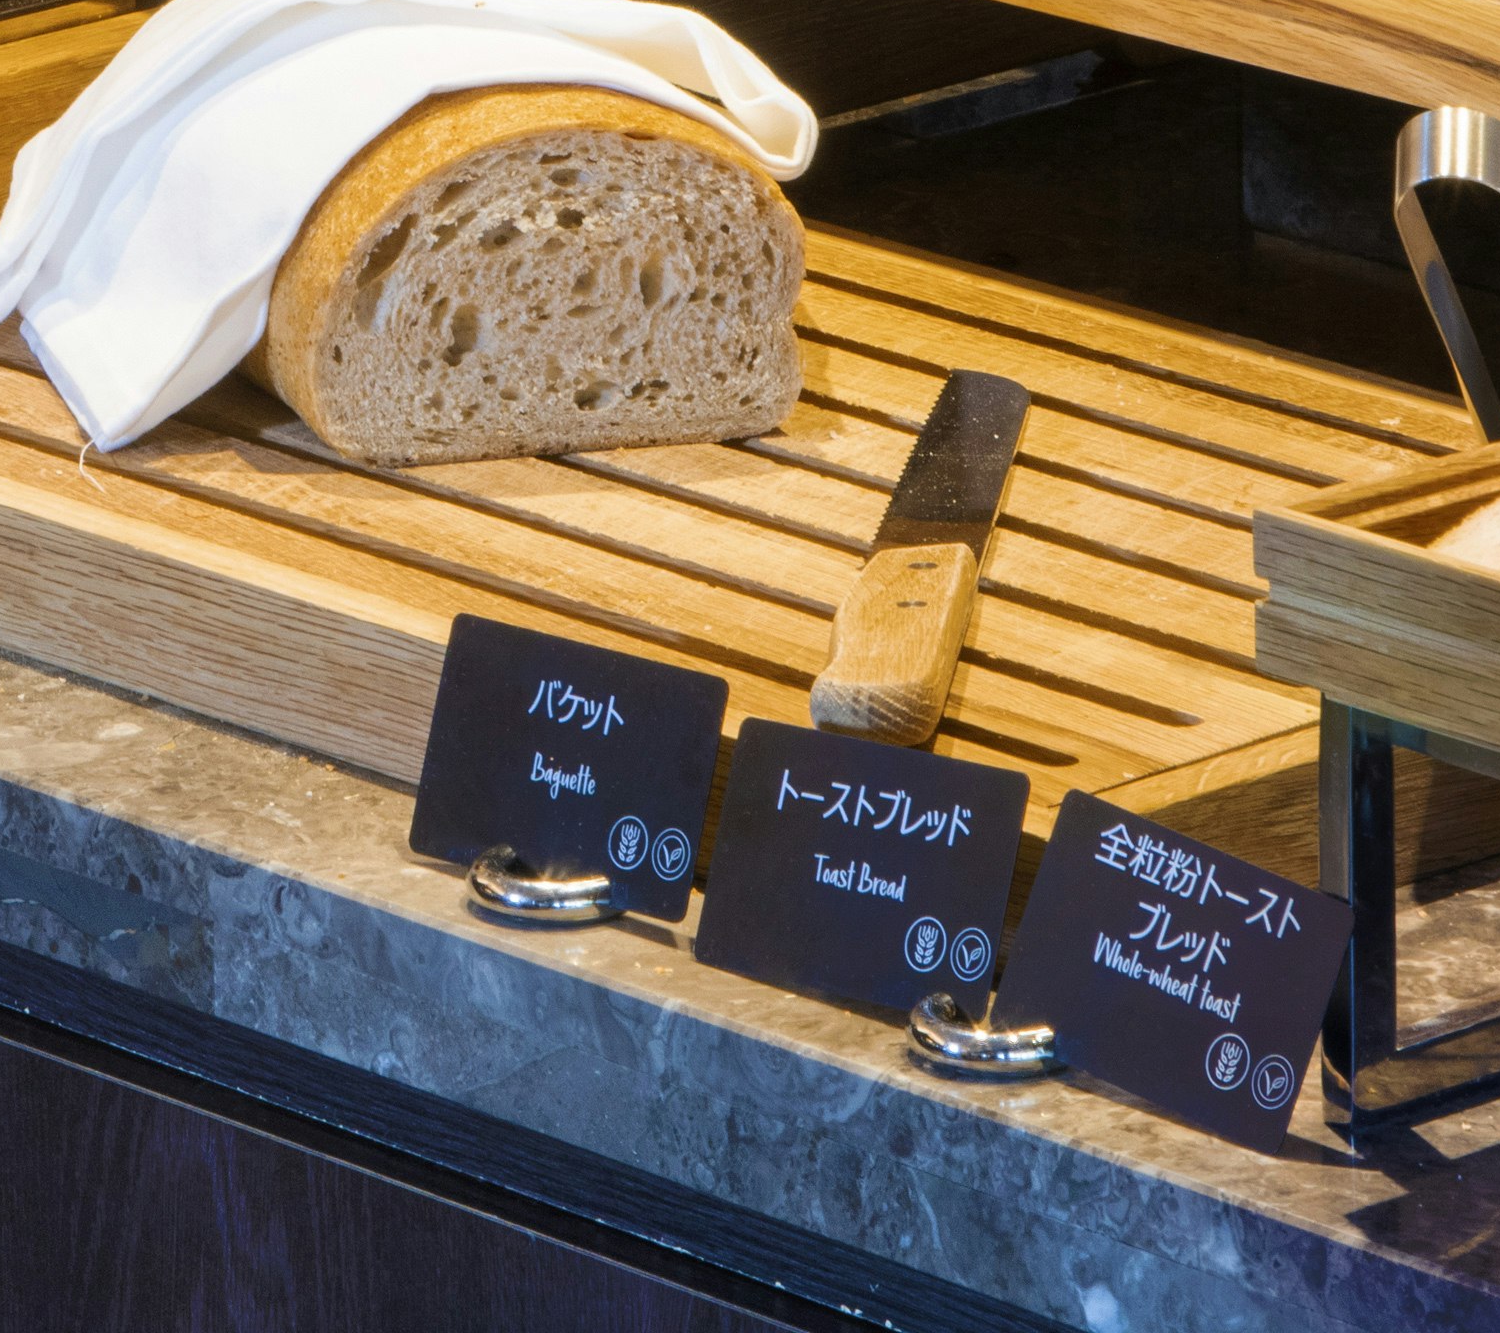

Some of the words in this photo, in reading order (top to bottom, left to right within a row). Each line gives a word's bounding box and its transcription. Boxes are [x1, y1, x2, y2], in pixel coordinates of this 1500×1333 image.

[527, 679, 625, 736] バケット
[529, 751, 597, 800] Baguette
[777, 768, 972, 847] トーストブレッド
[814, 853, 856, 891] Toast
[856, 862, 907, 902] Bread
[1094, 823, 1301, 939] 全粒粉トースト
[1129, 900, 1231, 973] ブレッド
[1093, 931, 1199, 1005] Whole-wheat
[1199, 979, 1242, 1024] toast
